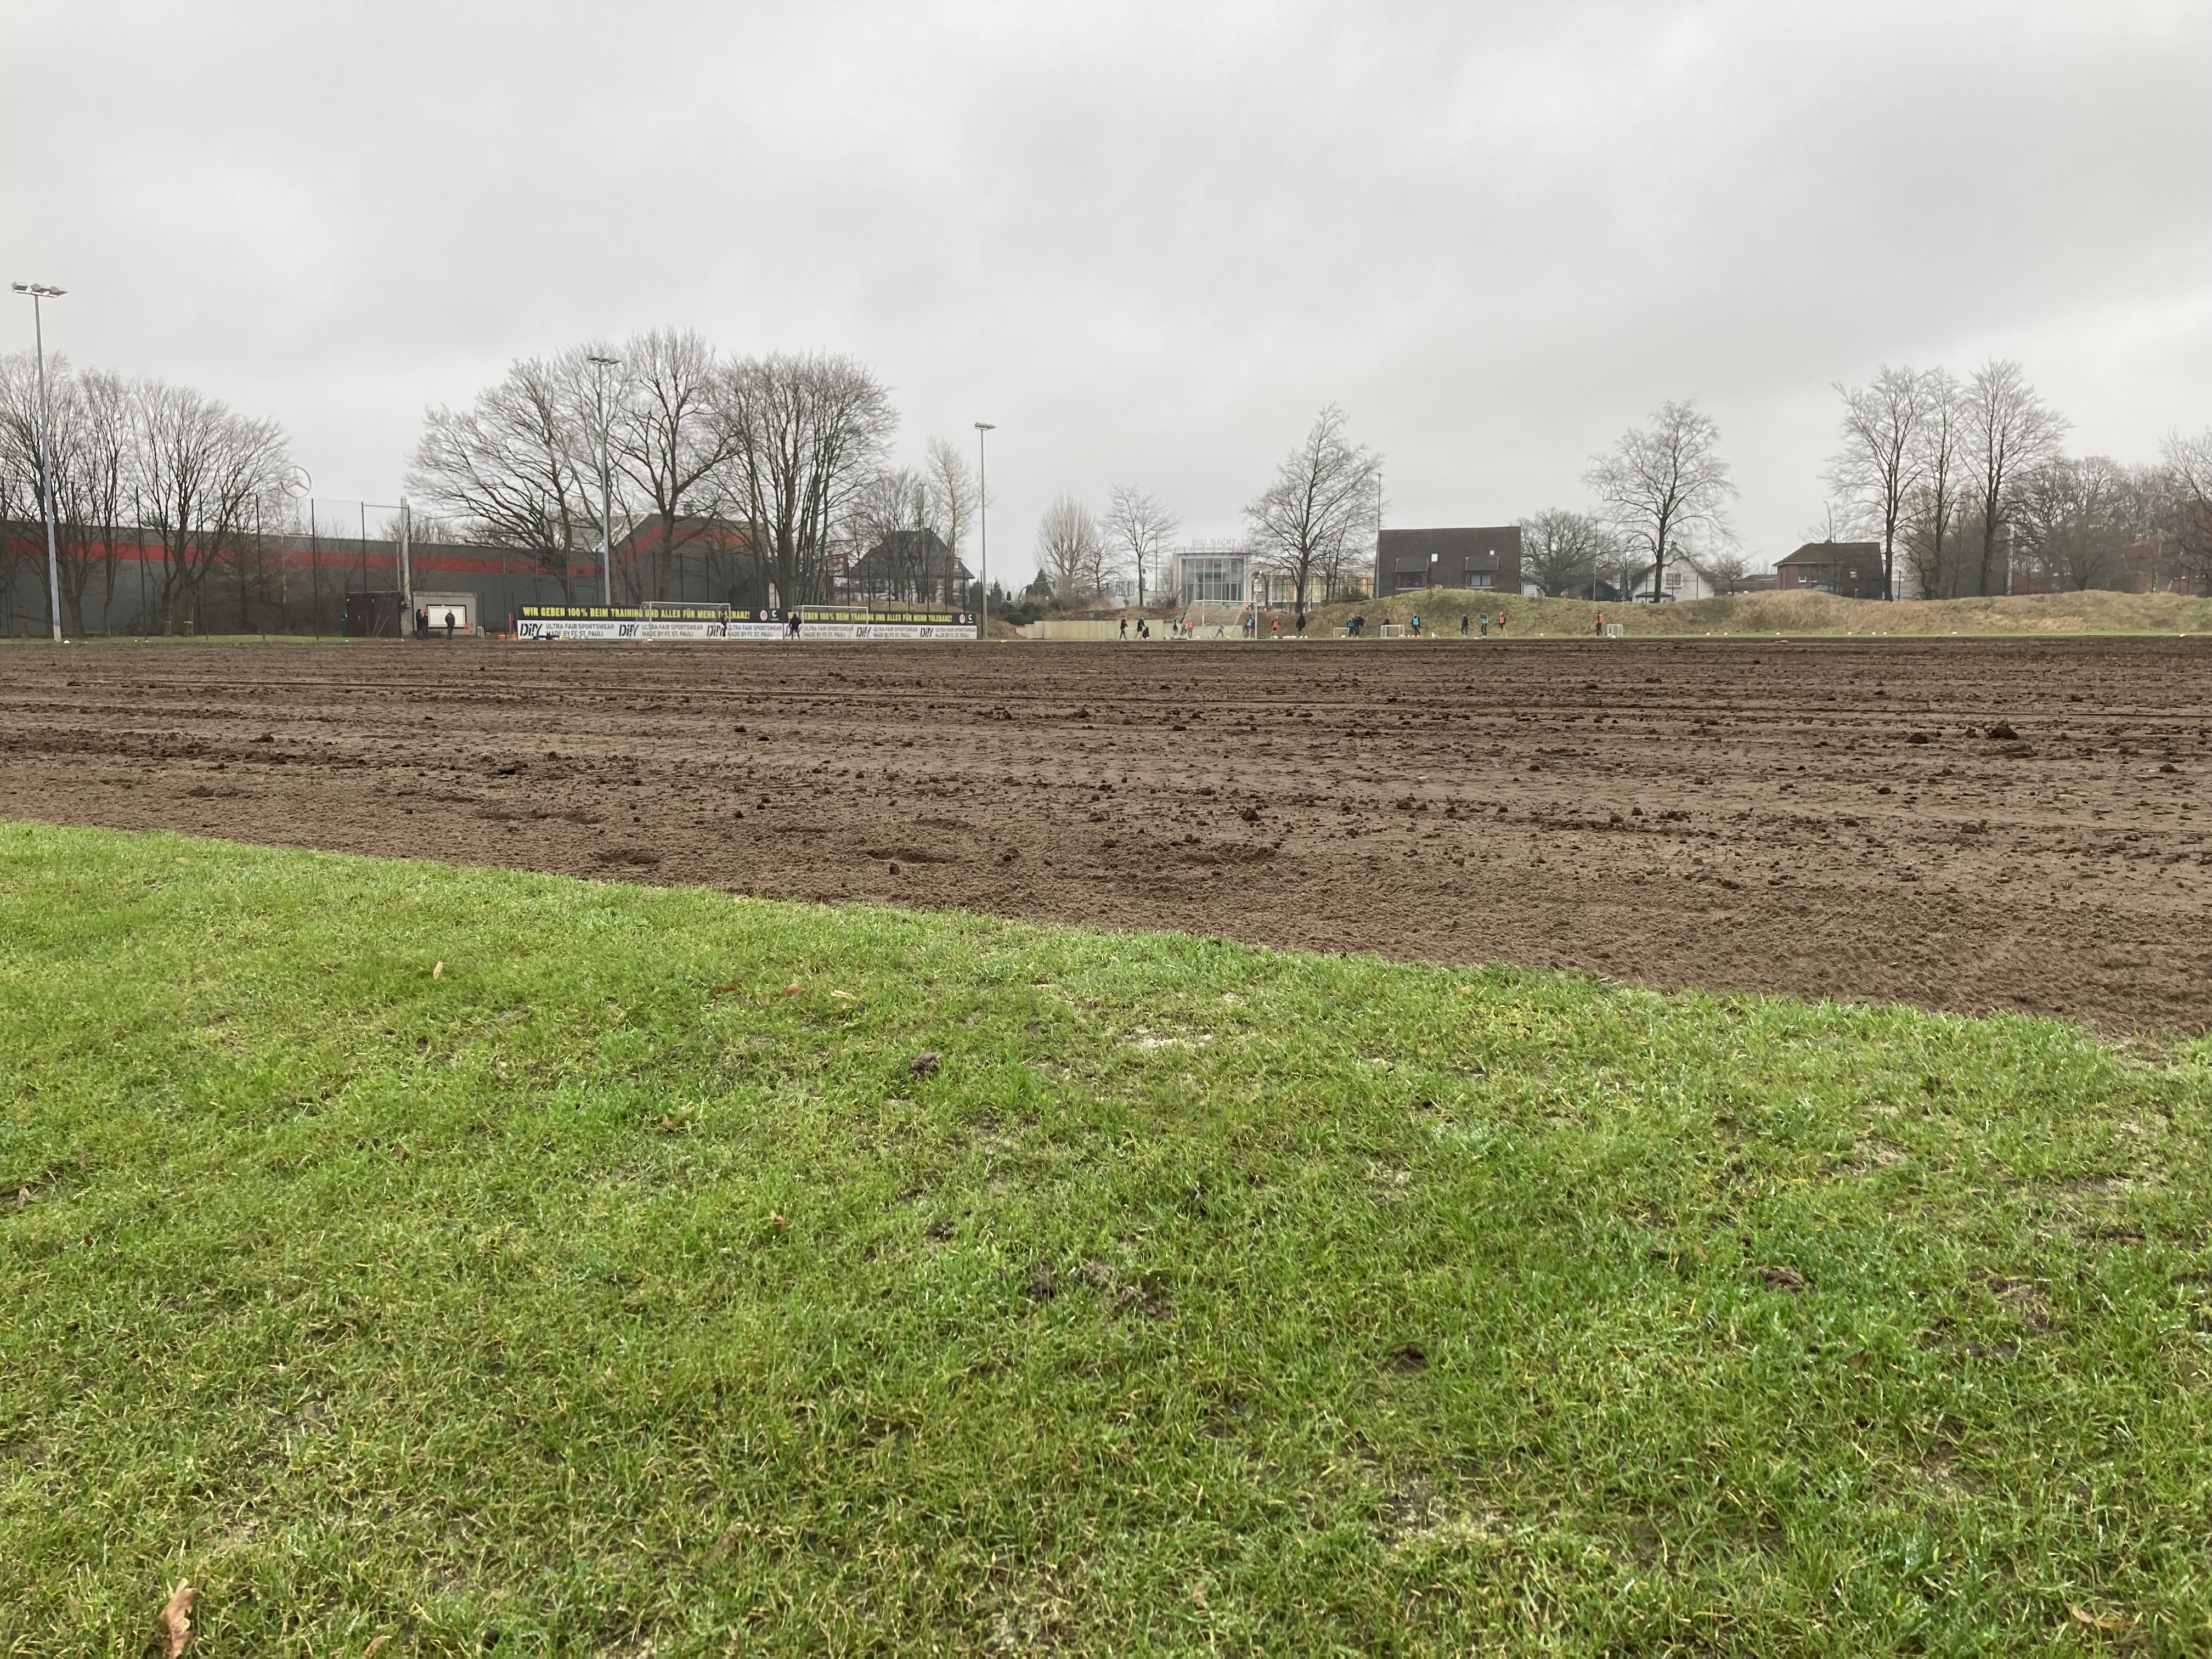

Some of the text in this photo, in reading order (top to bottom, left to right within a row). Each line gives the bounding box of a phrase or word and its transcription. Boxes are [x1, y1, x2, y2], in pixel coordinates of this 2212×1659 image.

[523, 607, 538, 616] WIR
[541, 607, 565, 617] GEBEN
[567, 608, 588, 617] 100%
[590, 608, 608, 617] BEIM
[611, 608, 643, 618] TRAINING
[661, 609, 681, 618] ALLES
[683, 608, 695, 618] FÜR
[697, 610, 715, 619] MEHR
[902, 613, 912, 622] FÜR
